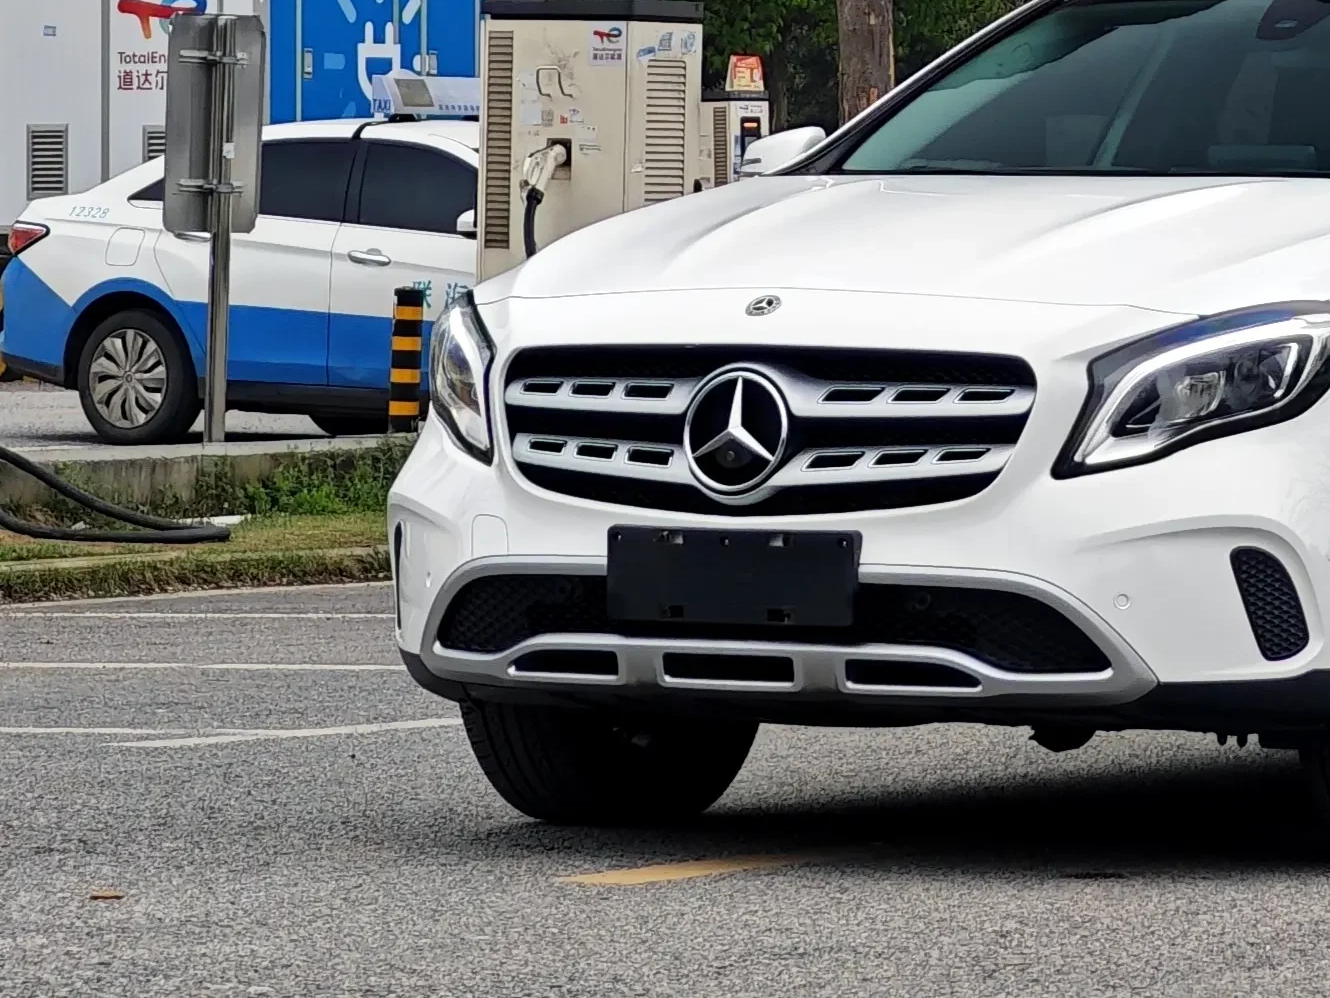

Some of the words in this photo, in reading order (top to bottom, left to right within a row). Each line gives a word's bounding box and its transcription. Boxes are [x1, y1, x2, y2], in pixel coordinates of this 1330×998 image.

[117, 52, 167, 64] TotalEn
[117, 69, 168, 91] 道达尔
[372, 99, 391, 111] TAXI
[69, 205, 110, 219] 12328
